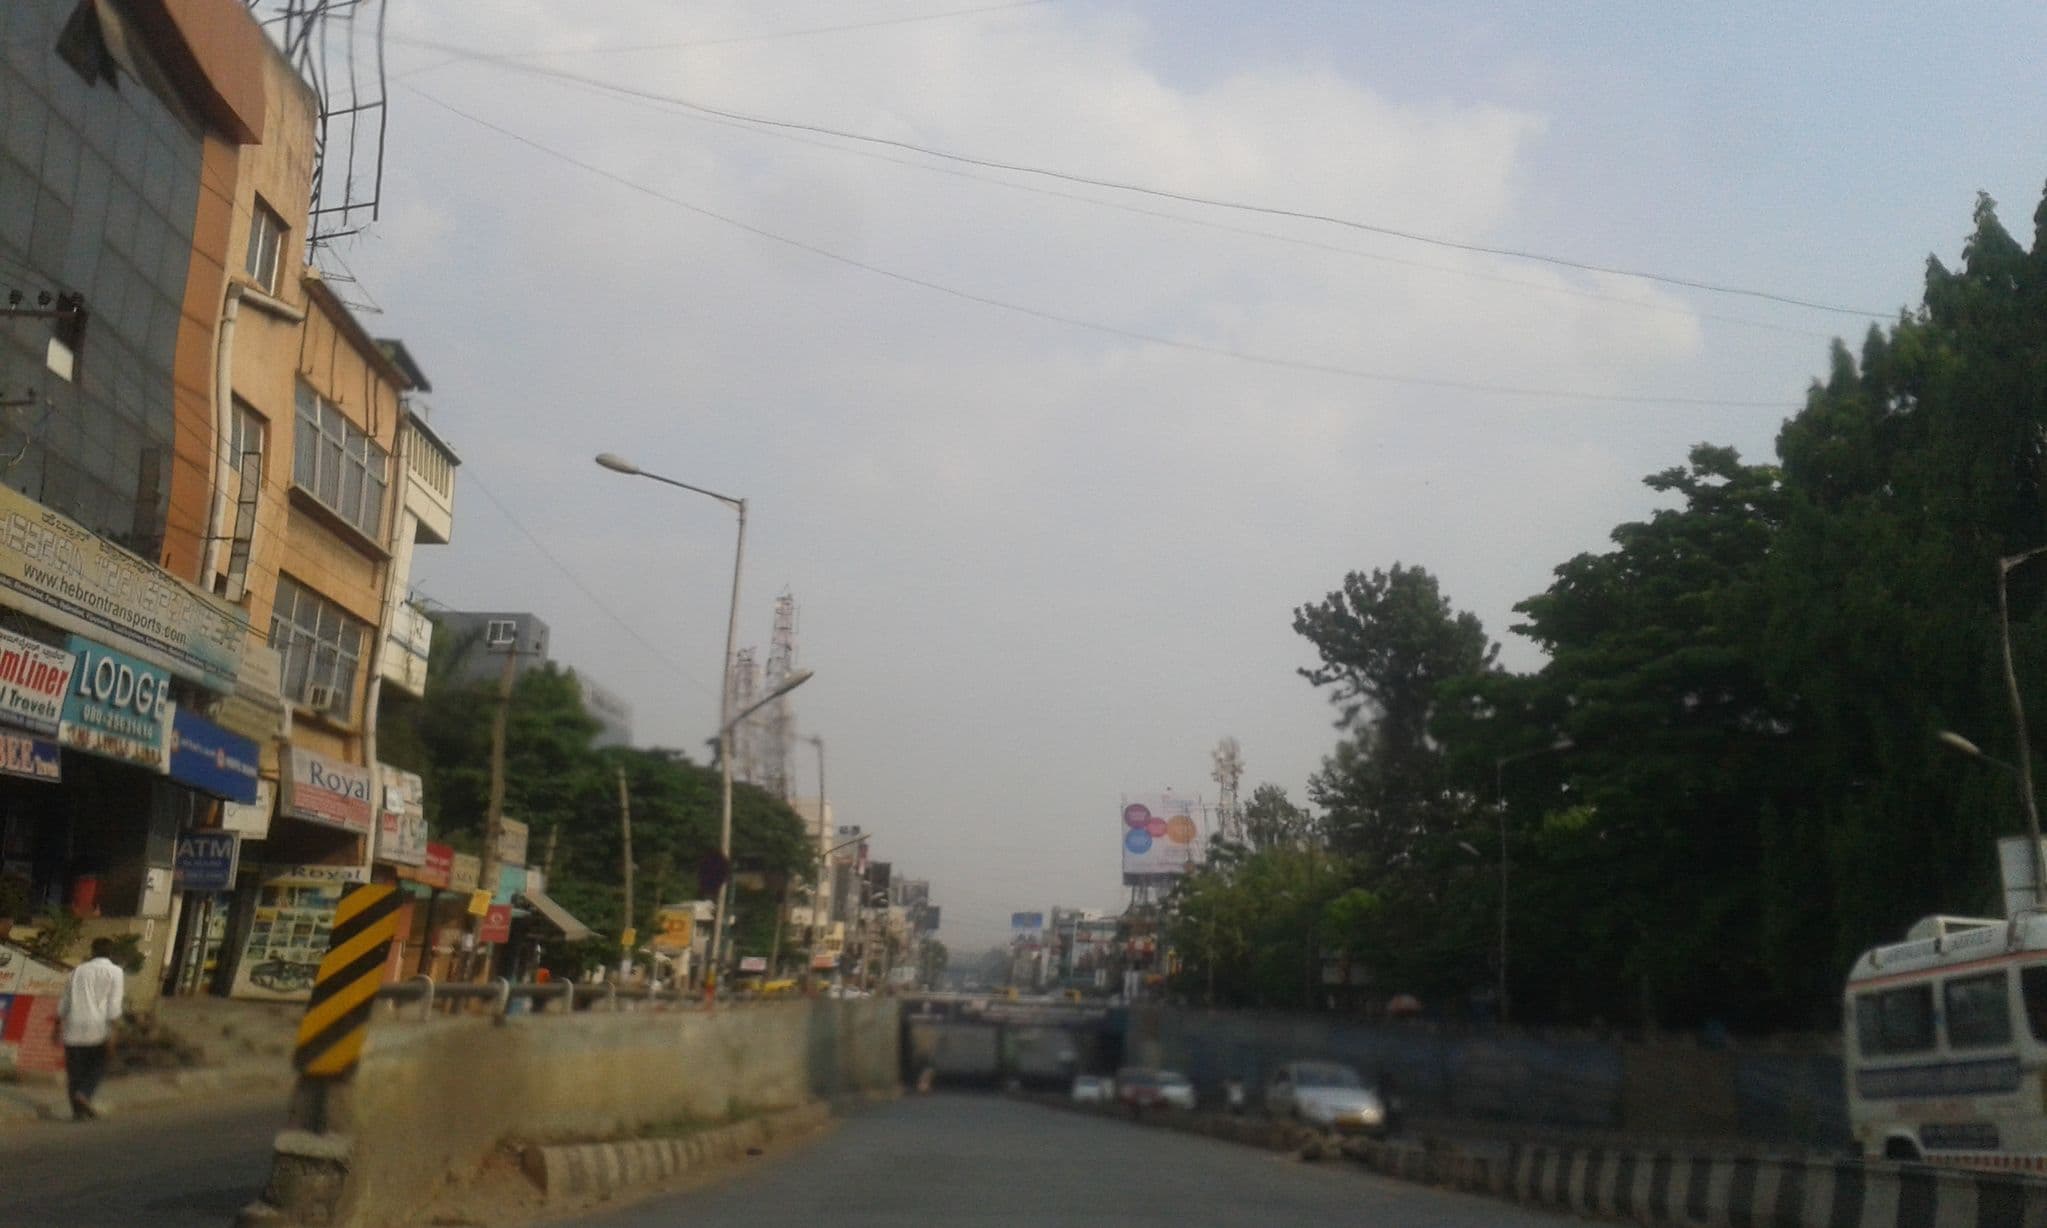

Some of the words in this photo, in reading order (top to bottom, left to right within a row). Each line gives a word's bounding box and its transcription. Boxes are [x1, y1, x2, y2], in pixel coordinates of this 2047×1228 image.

[23, 563, 188, 645] www.hebrontransports.com
[0, 646, 70, 698] mLiner
[79, 650, 170, 720] LODGE
[9, 688, 57, 719] Travels
[310, 759, 371, 802] Royal
[180, 837, 232, 859] ATM
[289, 865, 362, 882] Royal
